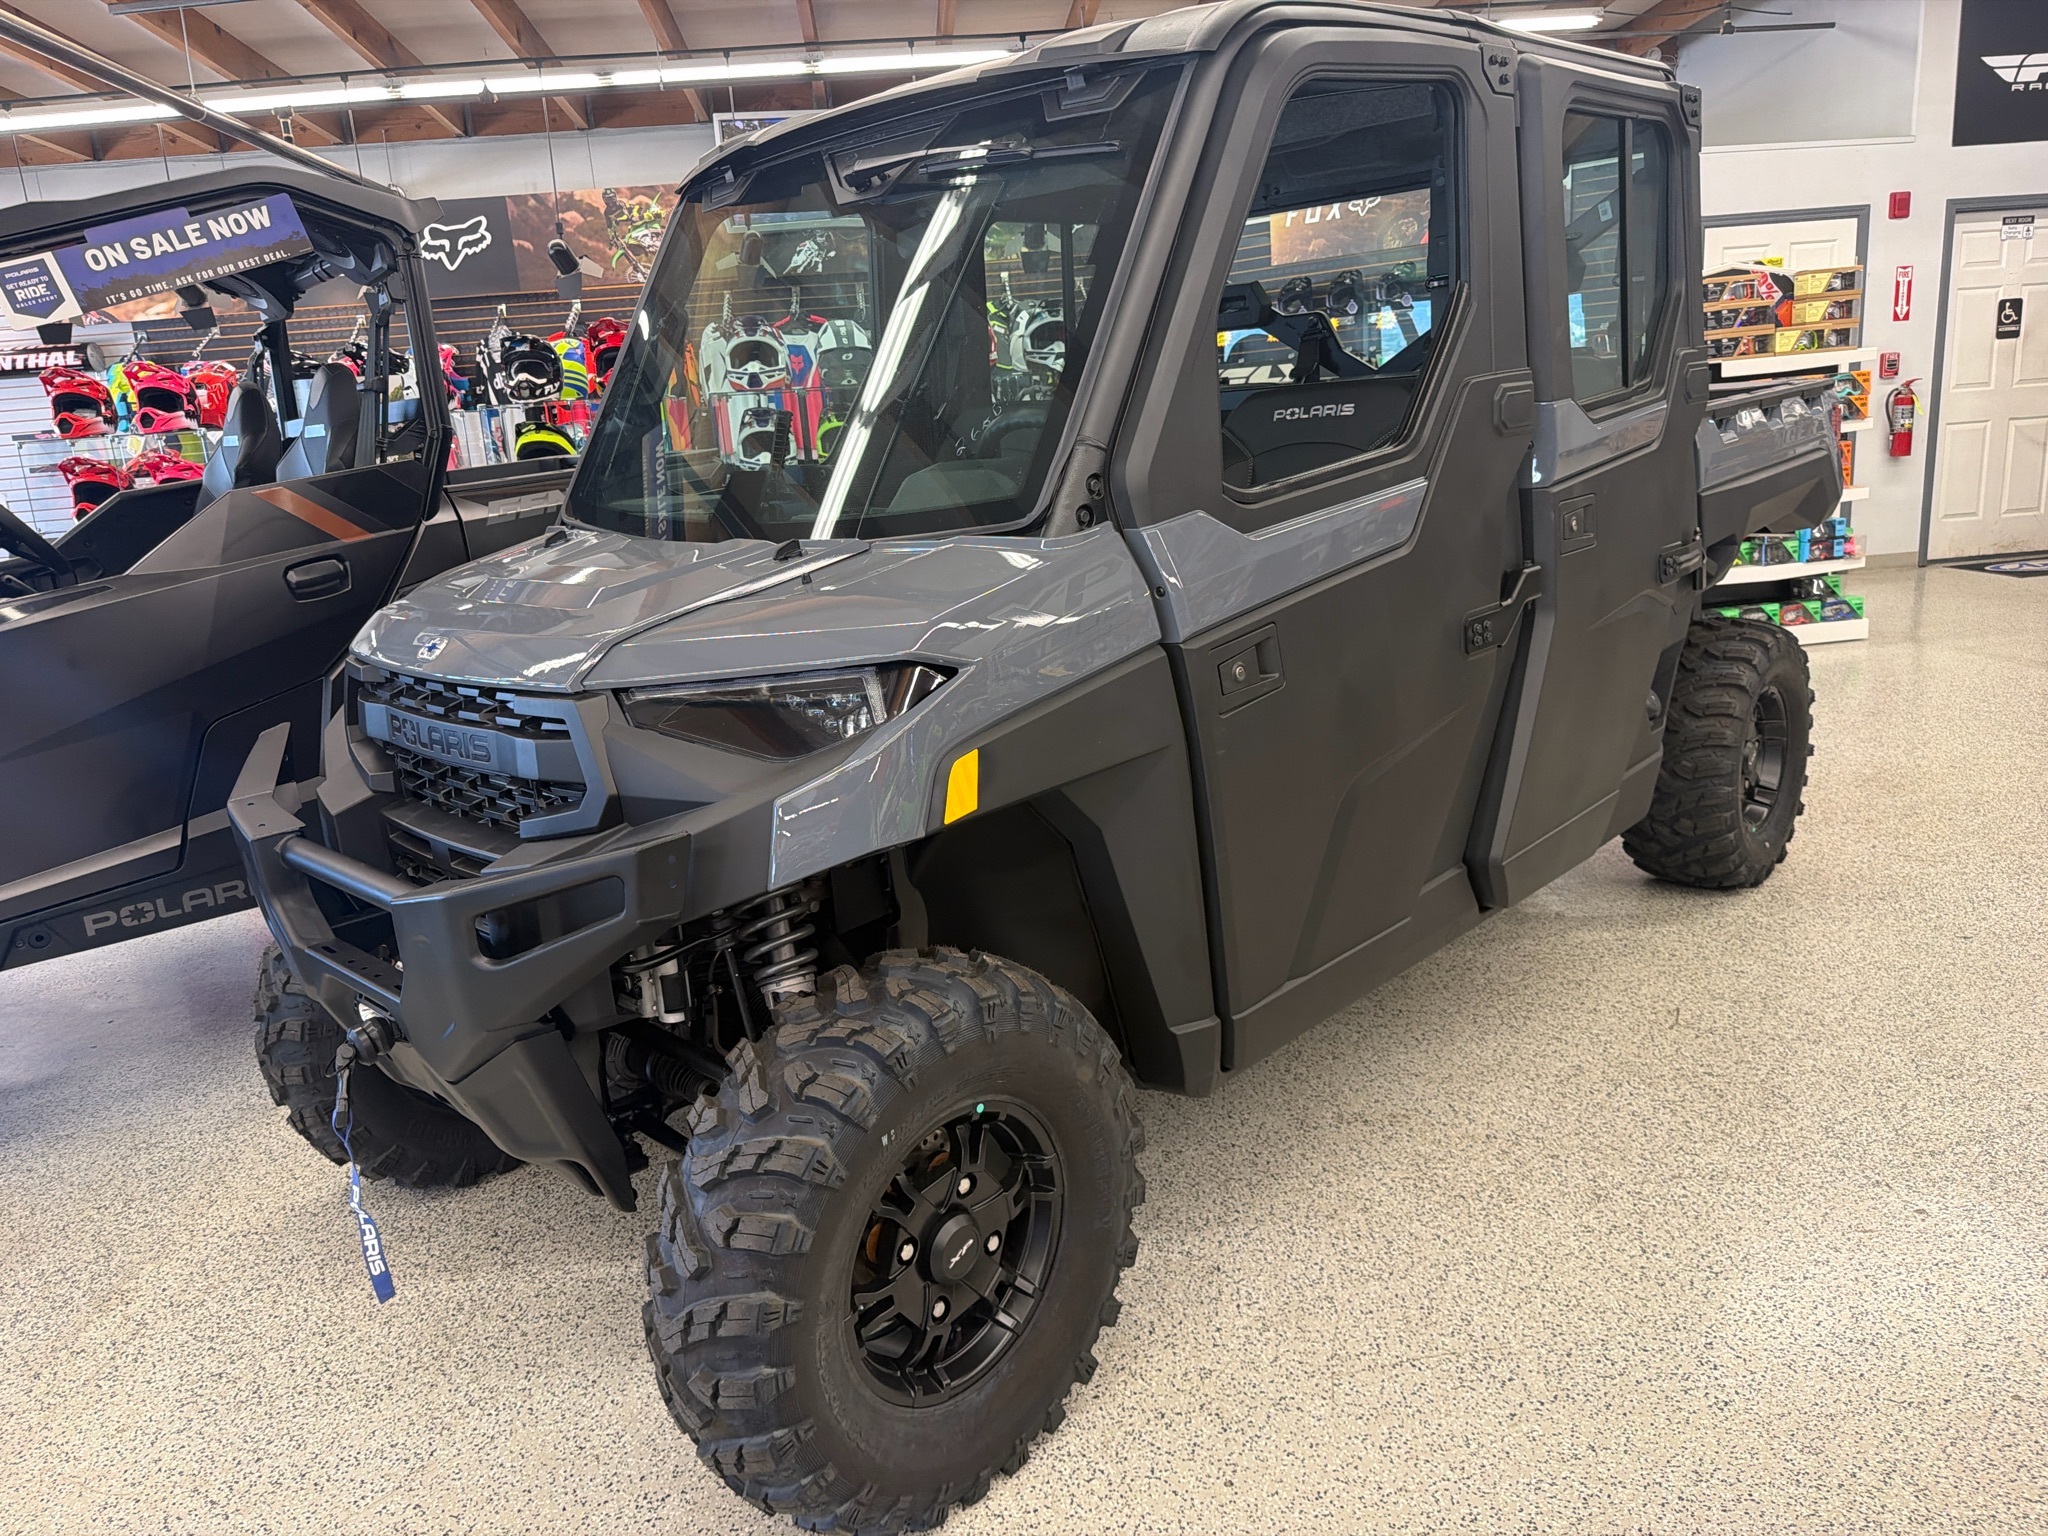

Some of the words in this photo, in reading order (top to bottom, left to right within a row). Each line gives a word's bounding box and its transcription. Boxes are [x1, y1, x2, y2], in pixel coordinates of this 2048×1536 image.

[84, 242, 130, 272] ON
[129, 222, 208, 260] SALE
[207, 205, 271, 241] NOW
[4, 266, 39, 280] POLARIS
[5, 281, 18, 290] GET
[18, 276, 39, 288] READY
[39, 275, 49, 283] TO
[105, 292, 127, 305] IT'S
[129, 287, 143, 298] GO
[144, 280, 174, 295] TIME.
[175, 273, 195, 286] ASK
[195, 269, 215, 281] FOR
[216, 263, 236, 275] OUR
[237, 255, 261, 270] BEST
[262, 249, 292, 263] DEAL.
[1898, 270, 1910, 279] FIRE
[14, 283, 51, 302] RIDE
[15, 299, 36, 309] SALES
[38, 294, 58, 304] EVENT
[544, 382, 560, 395] FLY
[1273, 403, 1355, 422] POLARIS
[390, 713, 492, 763] POLARIS
[83, 879, 249, 937] POLAR
